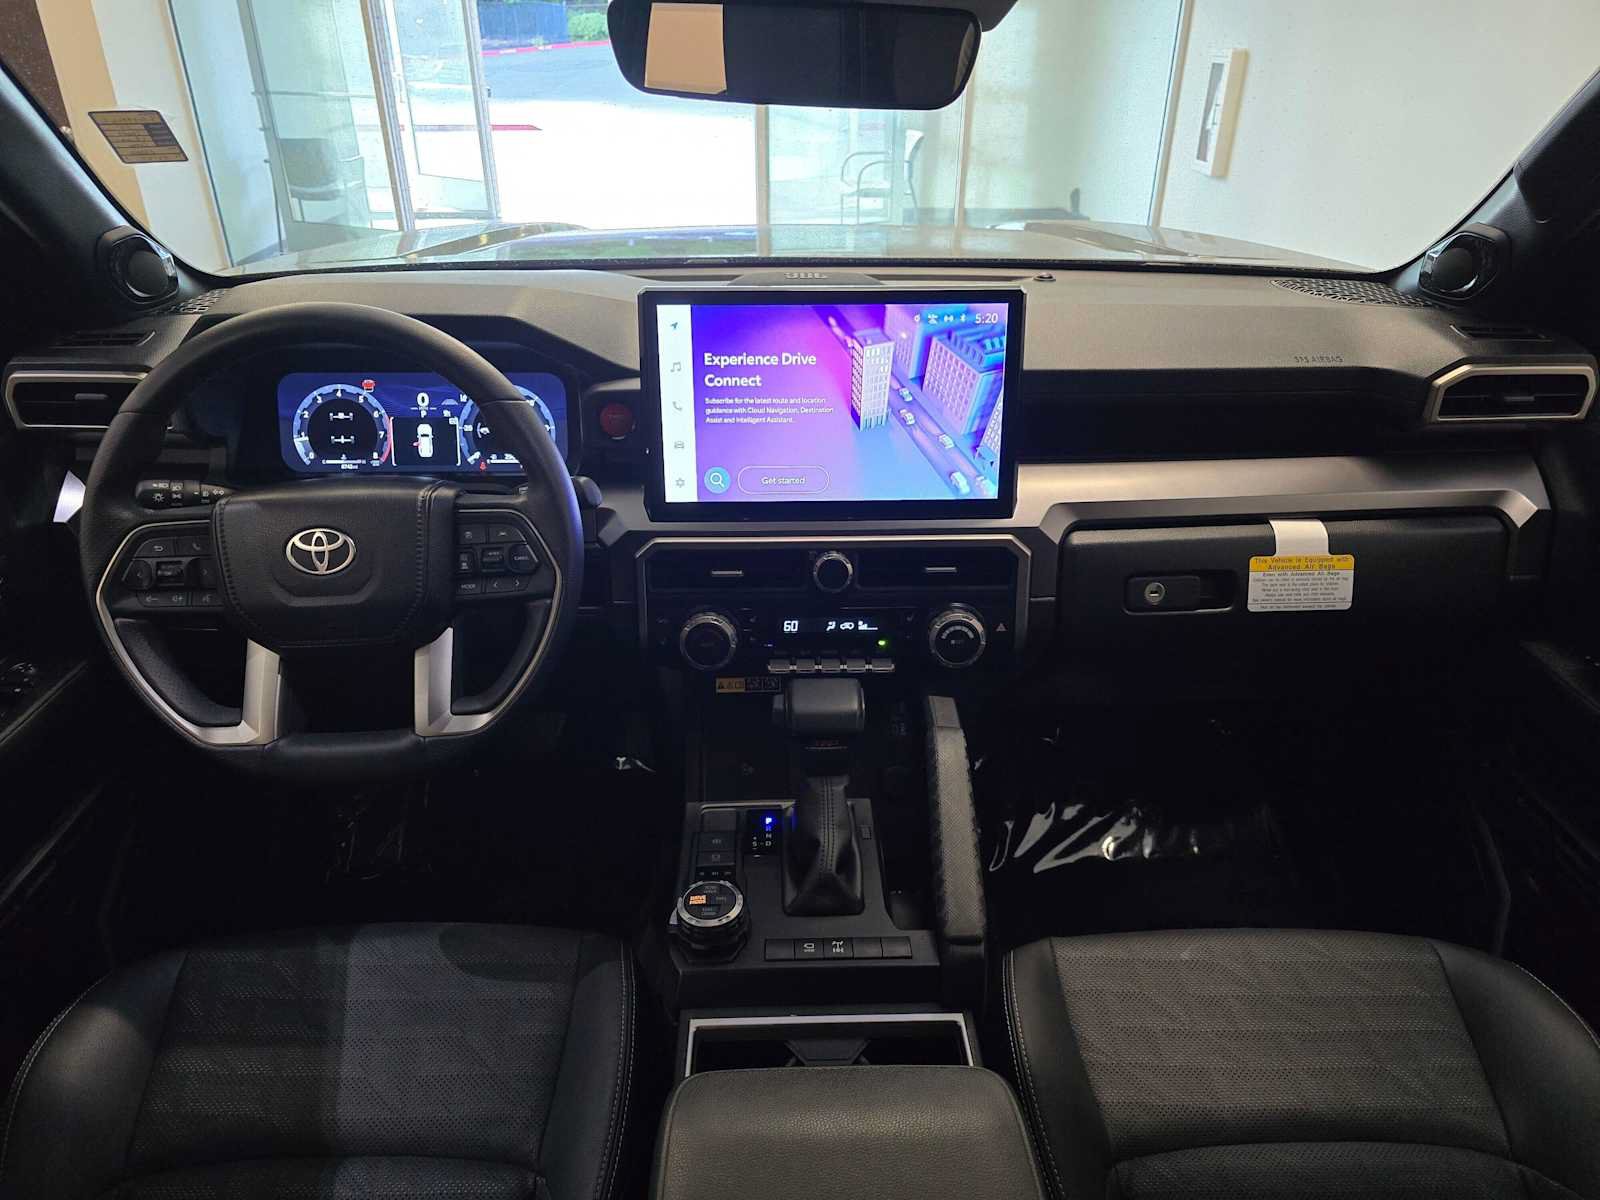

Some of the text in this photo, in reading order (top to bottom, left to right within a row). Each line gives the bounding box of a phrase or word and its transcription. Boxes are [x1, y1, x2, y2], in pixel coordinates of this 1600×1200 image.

[976, 313, 999, 324] 5:20
[704, 352, 817, 368] Experience Drive
[704, 374, 762, 387] Connect
[417, 392, 429, 406] 0
[705, 406, 733, 415] guidance
[761, 476, 805, 485] Get started
[1305, 556, 1334, 564] Equipped
[783, 620, 799, 632] 60
